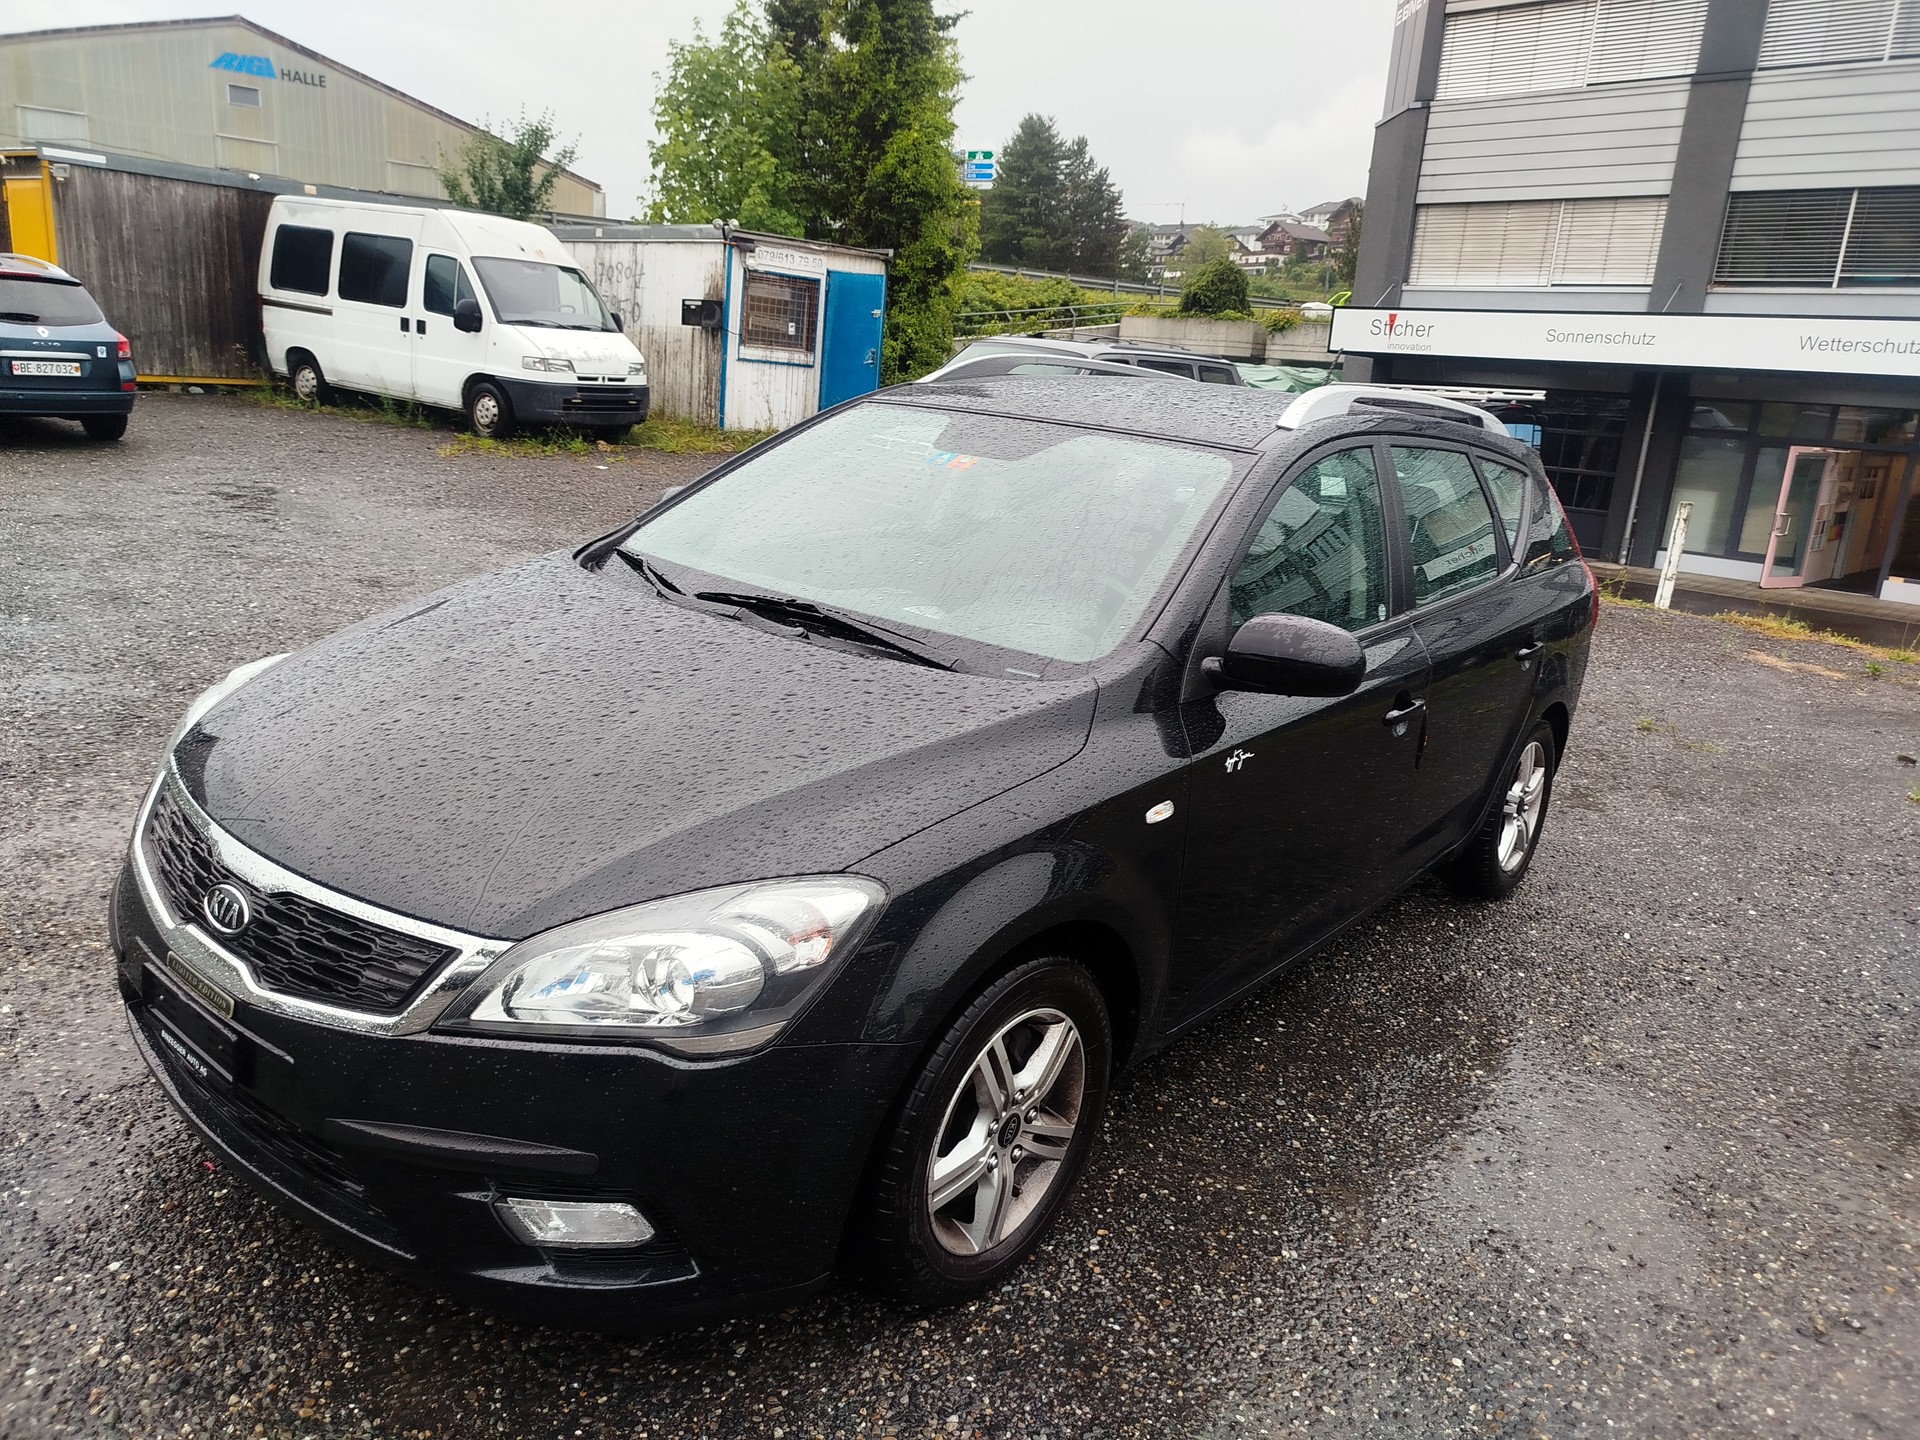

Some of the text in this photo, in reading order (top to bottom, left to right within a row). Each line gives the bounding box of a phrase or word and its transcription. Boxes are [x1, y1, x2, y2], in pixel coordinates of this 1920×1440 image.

[281, 68, 327, 88] HALLE
[758, 249, 795, 264] 079/613
[798, 255, 810, 266] 79
[1370, 314, 1434, 341] Sticher
[1545, 328, 1657, 346] Sonnenschutz
[1387, 343, 1432, 352] innovation
[210, 890, 240, 929] KIA
[172, 960, 227, 1009] LIMITED EDITION
[186, 1053, 200, 1069] AUTO
